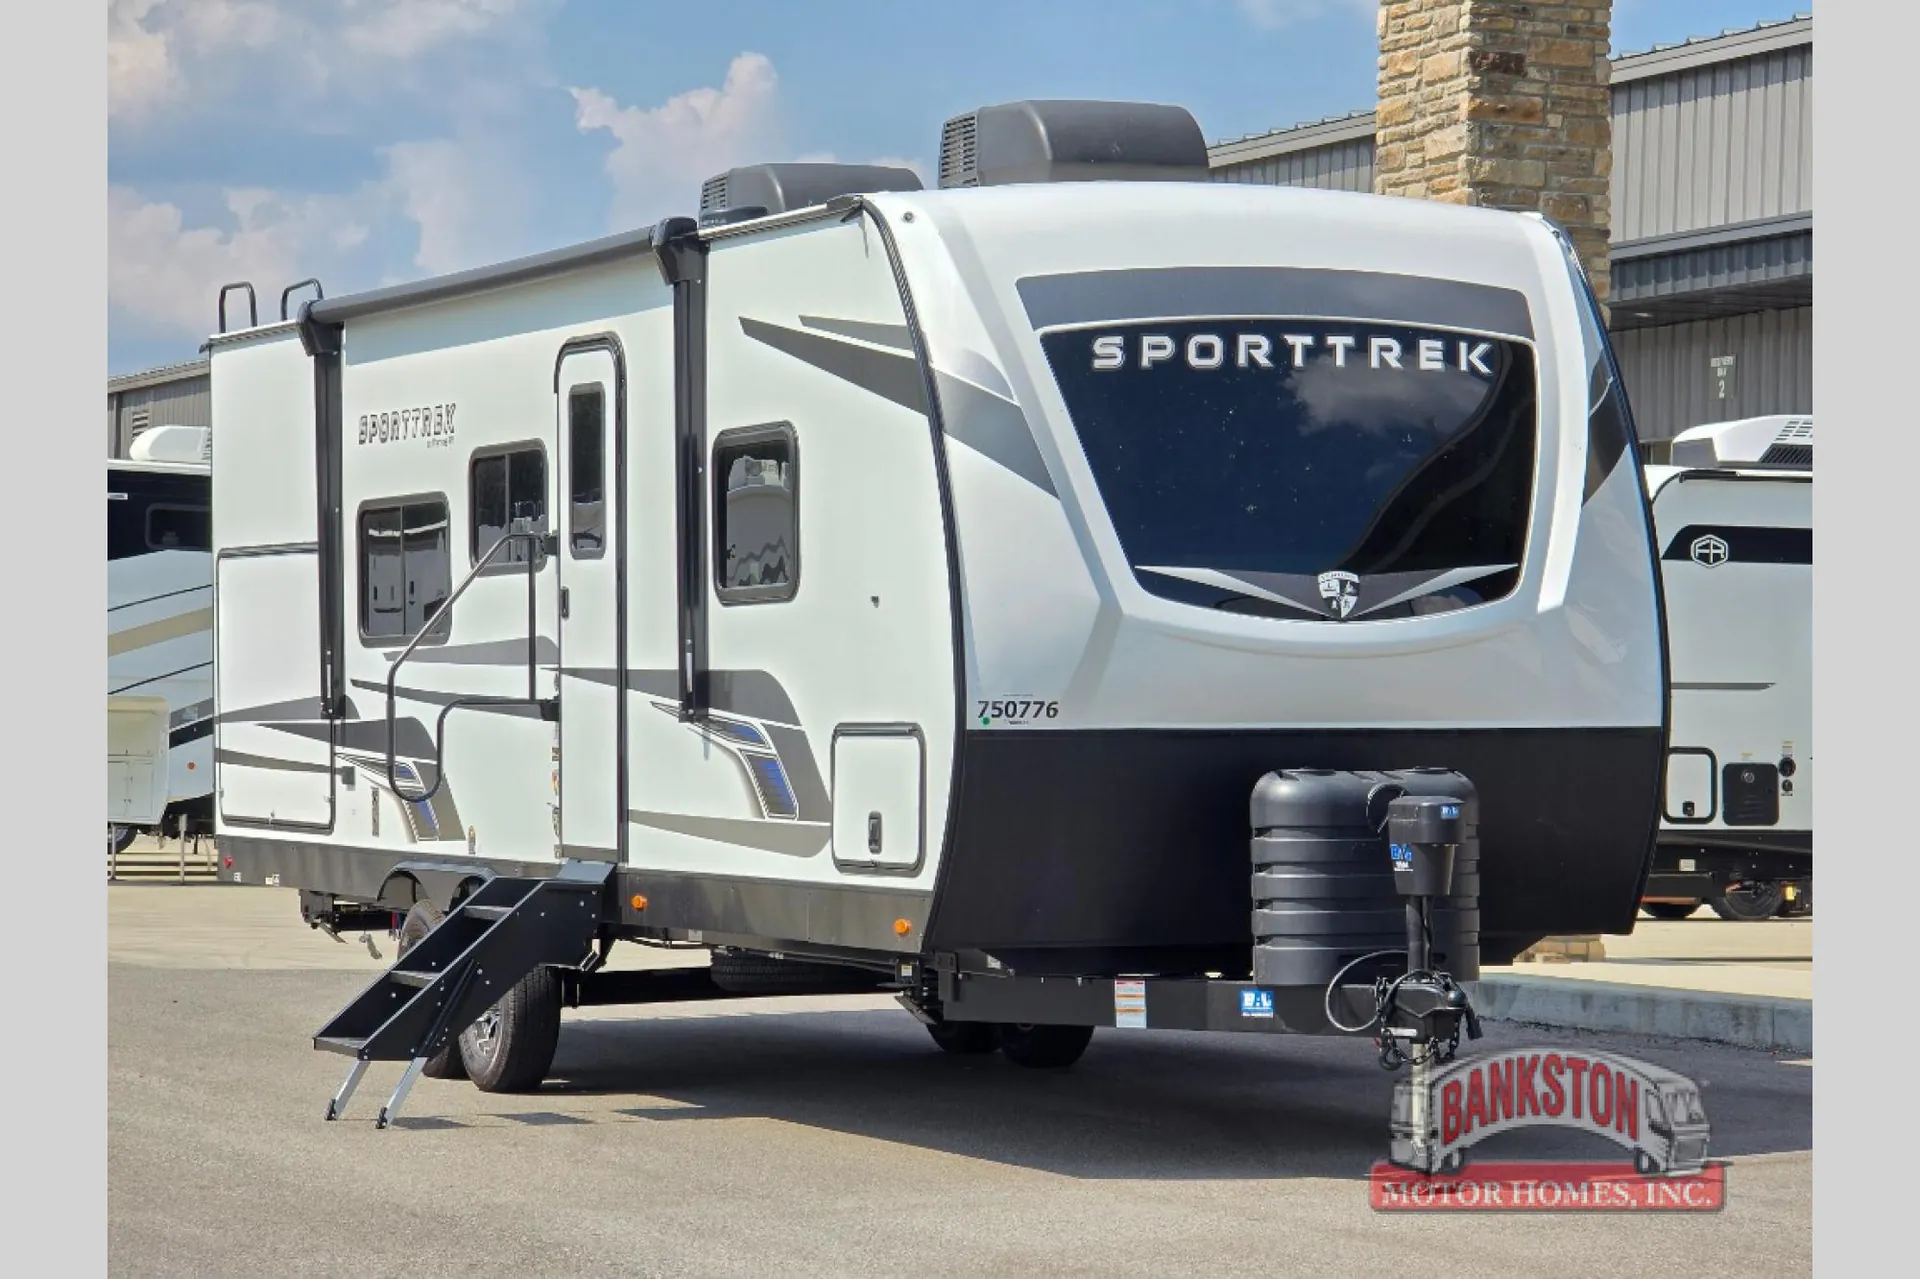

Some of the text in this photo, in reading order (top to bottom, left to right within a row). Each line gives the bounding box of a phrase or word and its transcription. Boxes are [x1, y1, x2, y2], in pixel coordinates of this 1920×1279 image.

[1091, 333, 1494, 376] SPORTTREK
[358, 402, 456, 445] SPORTTREK
[977, 700, 1059, 718] 750776
